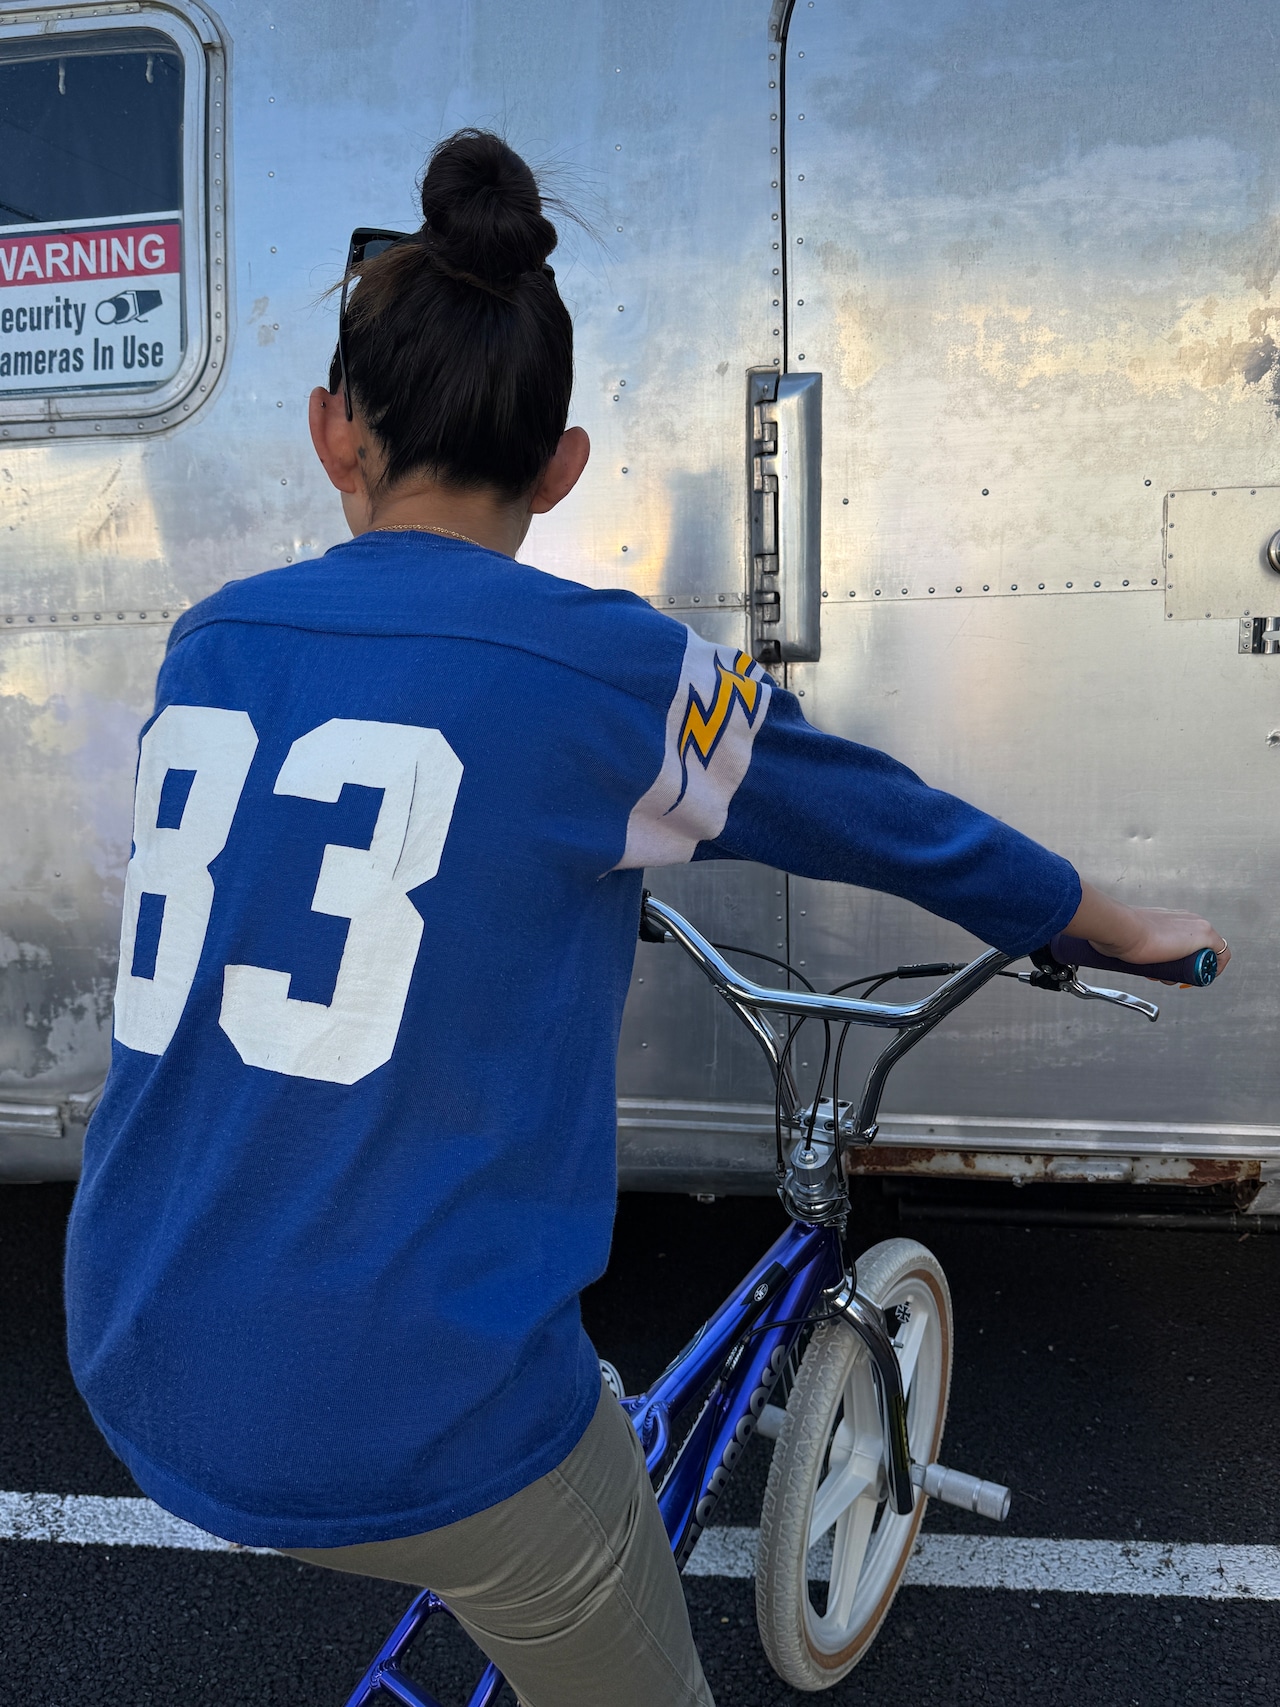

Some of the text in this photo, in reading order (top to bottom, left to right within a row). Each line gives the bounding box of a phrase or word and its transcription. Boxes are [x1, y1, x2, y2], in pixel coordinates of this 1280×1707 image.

[1, 296, 87, 336] ecurity
[0, 335, 164, 377] ameras In Use
[114, 705, 465, 1086] 83
